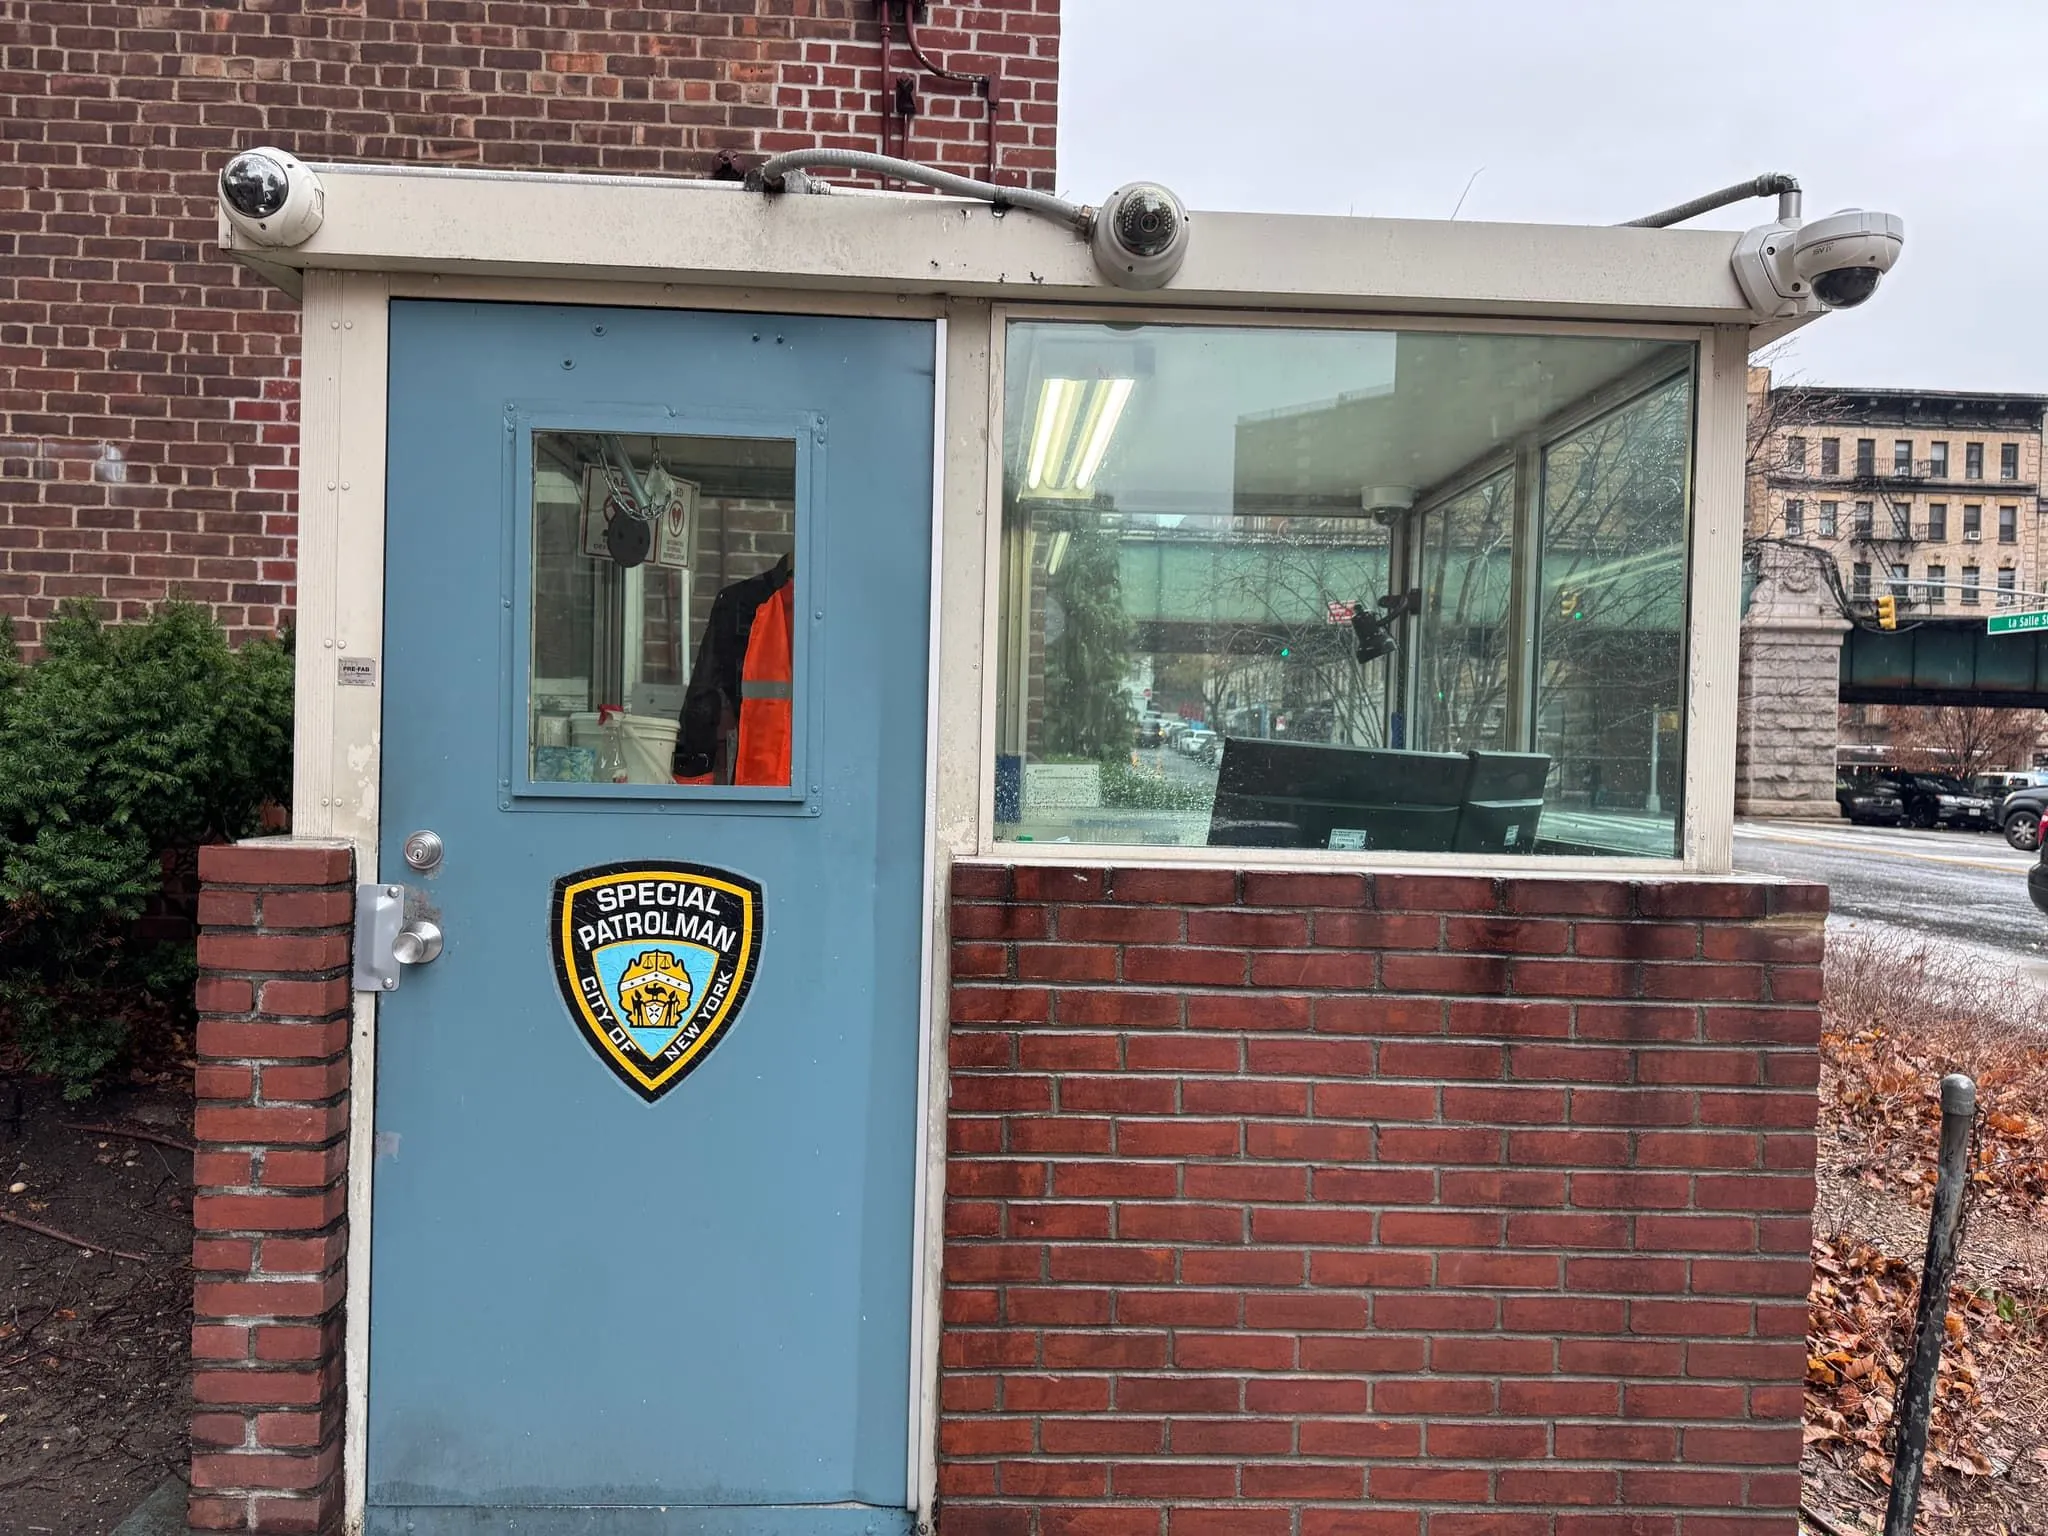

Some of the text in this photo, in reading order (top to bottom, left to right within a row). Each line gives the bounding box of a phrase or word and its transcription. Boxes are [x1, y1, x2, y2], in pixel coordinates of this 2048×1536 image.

[2008, 618, 2017, 628] La
[2019, 615, 2039, 627] Salle
[596, 882, 721, 916] SPECIAL
[577, 911, 736, 953] PATROLMAN
[581, 970, 733, 1061] CITY OF NEW YORK
